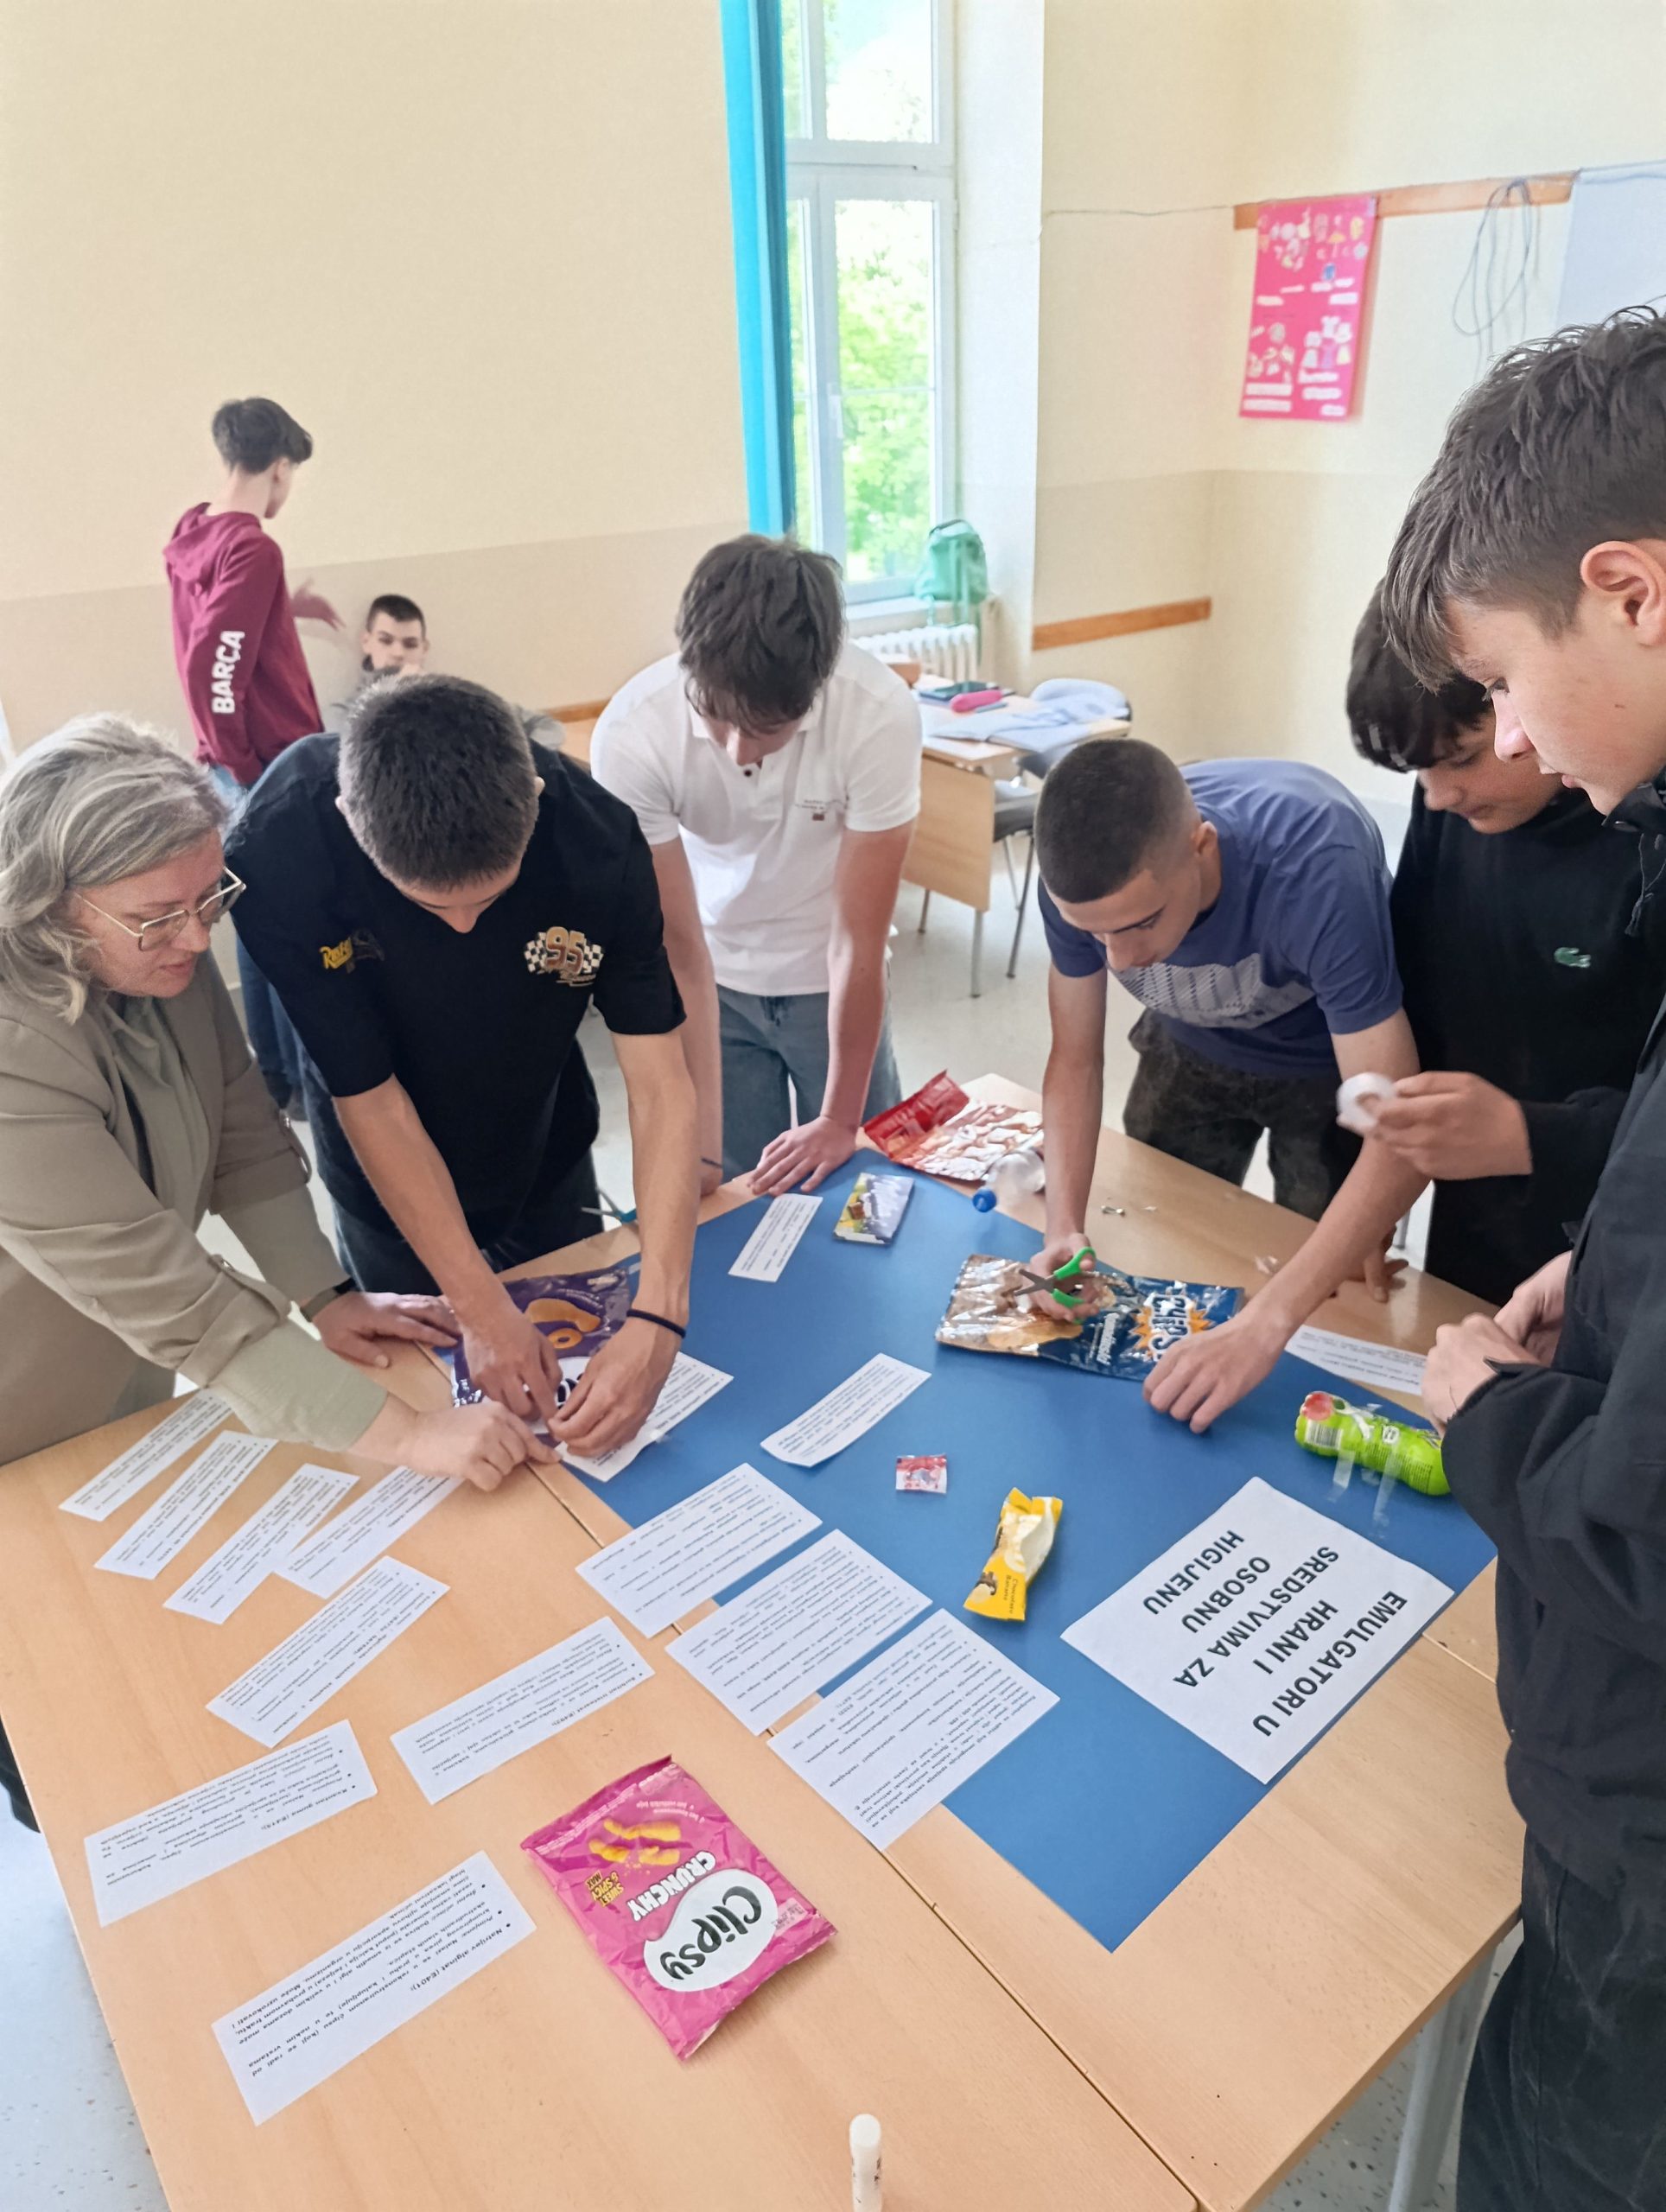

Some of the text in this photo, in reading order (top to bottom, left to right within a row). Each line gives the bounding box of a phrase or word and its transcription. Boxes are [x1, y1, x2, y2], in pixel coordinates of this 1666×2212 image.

[545, 925, 584, 976] 95
[1144, 1531, 1244, 1614] HIGIJENU
[1182, 1558, 1269, 1632] OSOBNU
[1173, 1548, 1339, 1687] SREDSTVIMA ZA
[1254, 1601, 1338, 1674] HRANI I
[1253, 1592, 1407, 1736] EMULGATORI U
[587, 1872, 601, 1889] MAX
[590, 1877, 614, 1901] SPICY
[598, 1881, 624, 1908] SWEET
[626, 1850, 716, 1922] CRUNCHY
[659, 1885, 763, 1981] Clipsy
